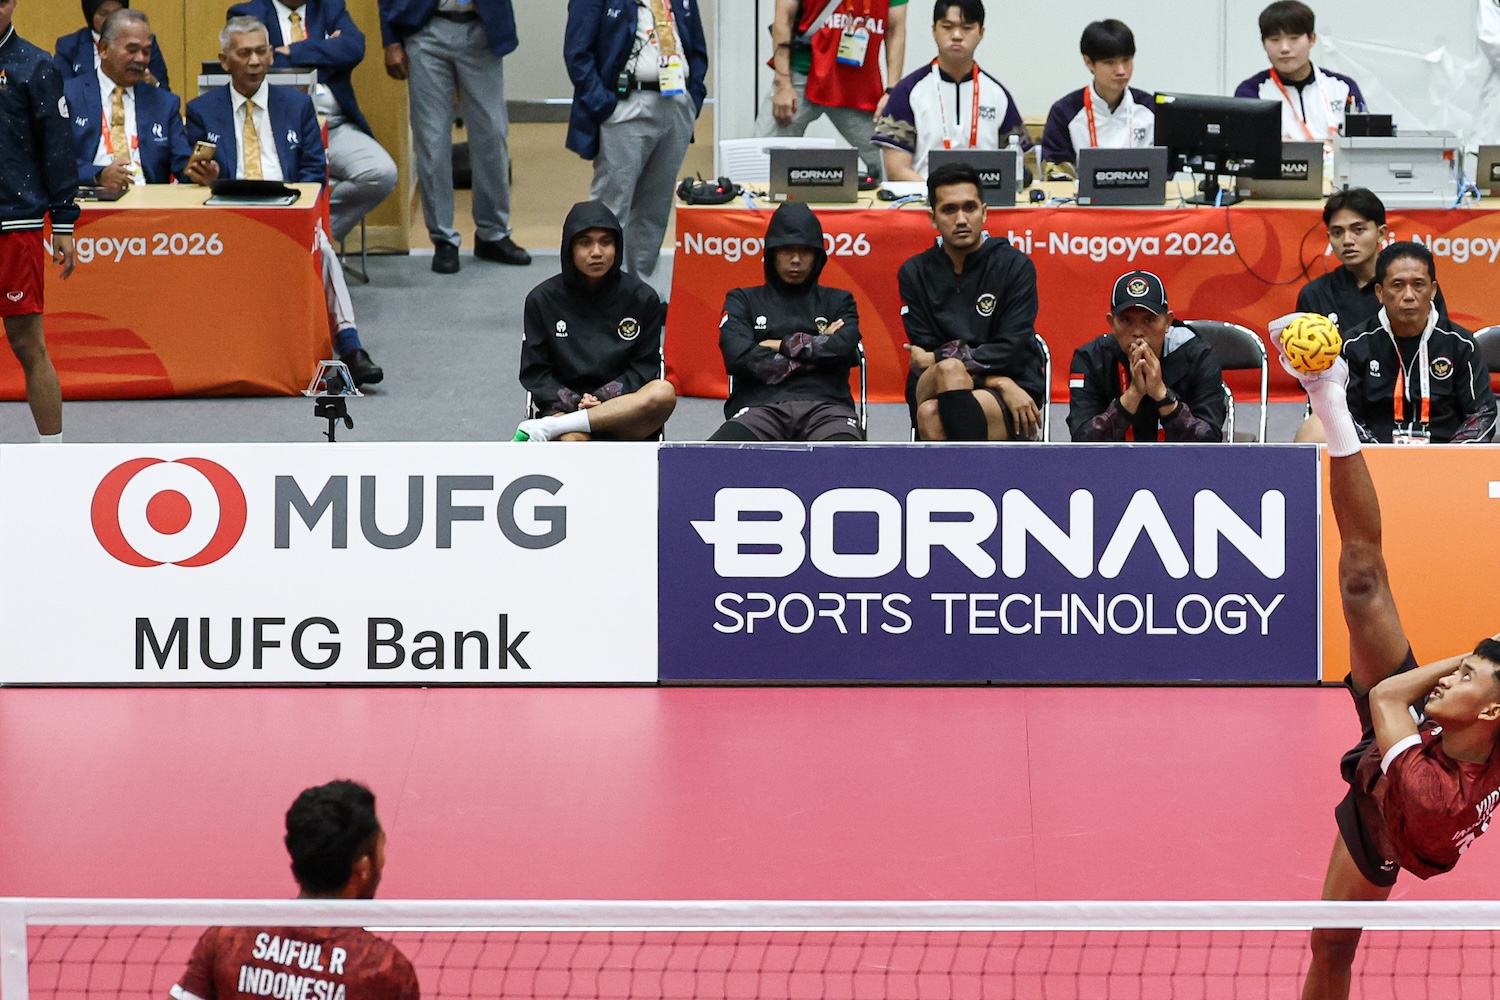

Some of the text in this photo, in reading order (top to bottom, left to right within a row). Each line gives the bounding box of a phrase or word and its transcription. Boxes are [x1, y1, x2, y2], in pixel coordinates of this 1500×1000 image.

[790, 170, 843, 179] BORNAN
[1096, 171, 1148, 180] BORNAN
[1281, 164, 1307, 172] NAN
[152, 233, 224, 256] 2026
[823, 233, 871, 256] 026
[1008, 230, 1235, 262] hi-Nagoya 2026
[274, 474, 567, 549] MUFG
[690, 487, 1286, 579] BORNAN
[713, 593, 1285, 636] SPORTS TECHNOLOGY
[134, 613, 532, 671] MUFG Bank
[252, 932, 347, 976] SAIFUL R
